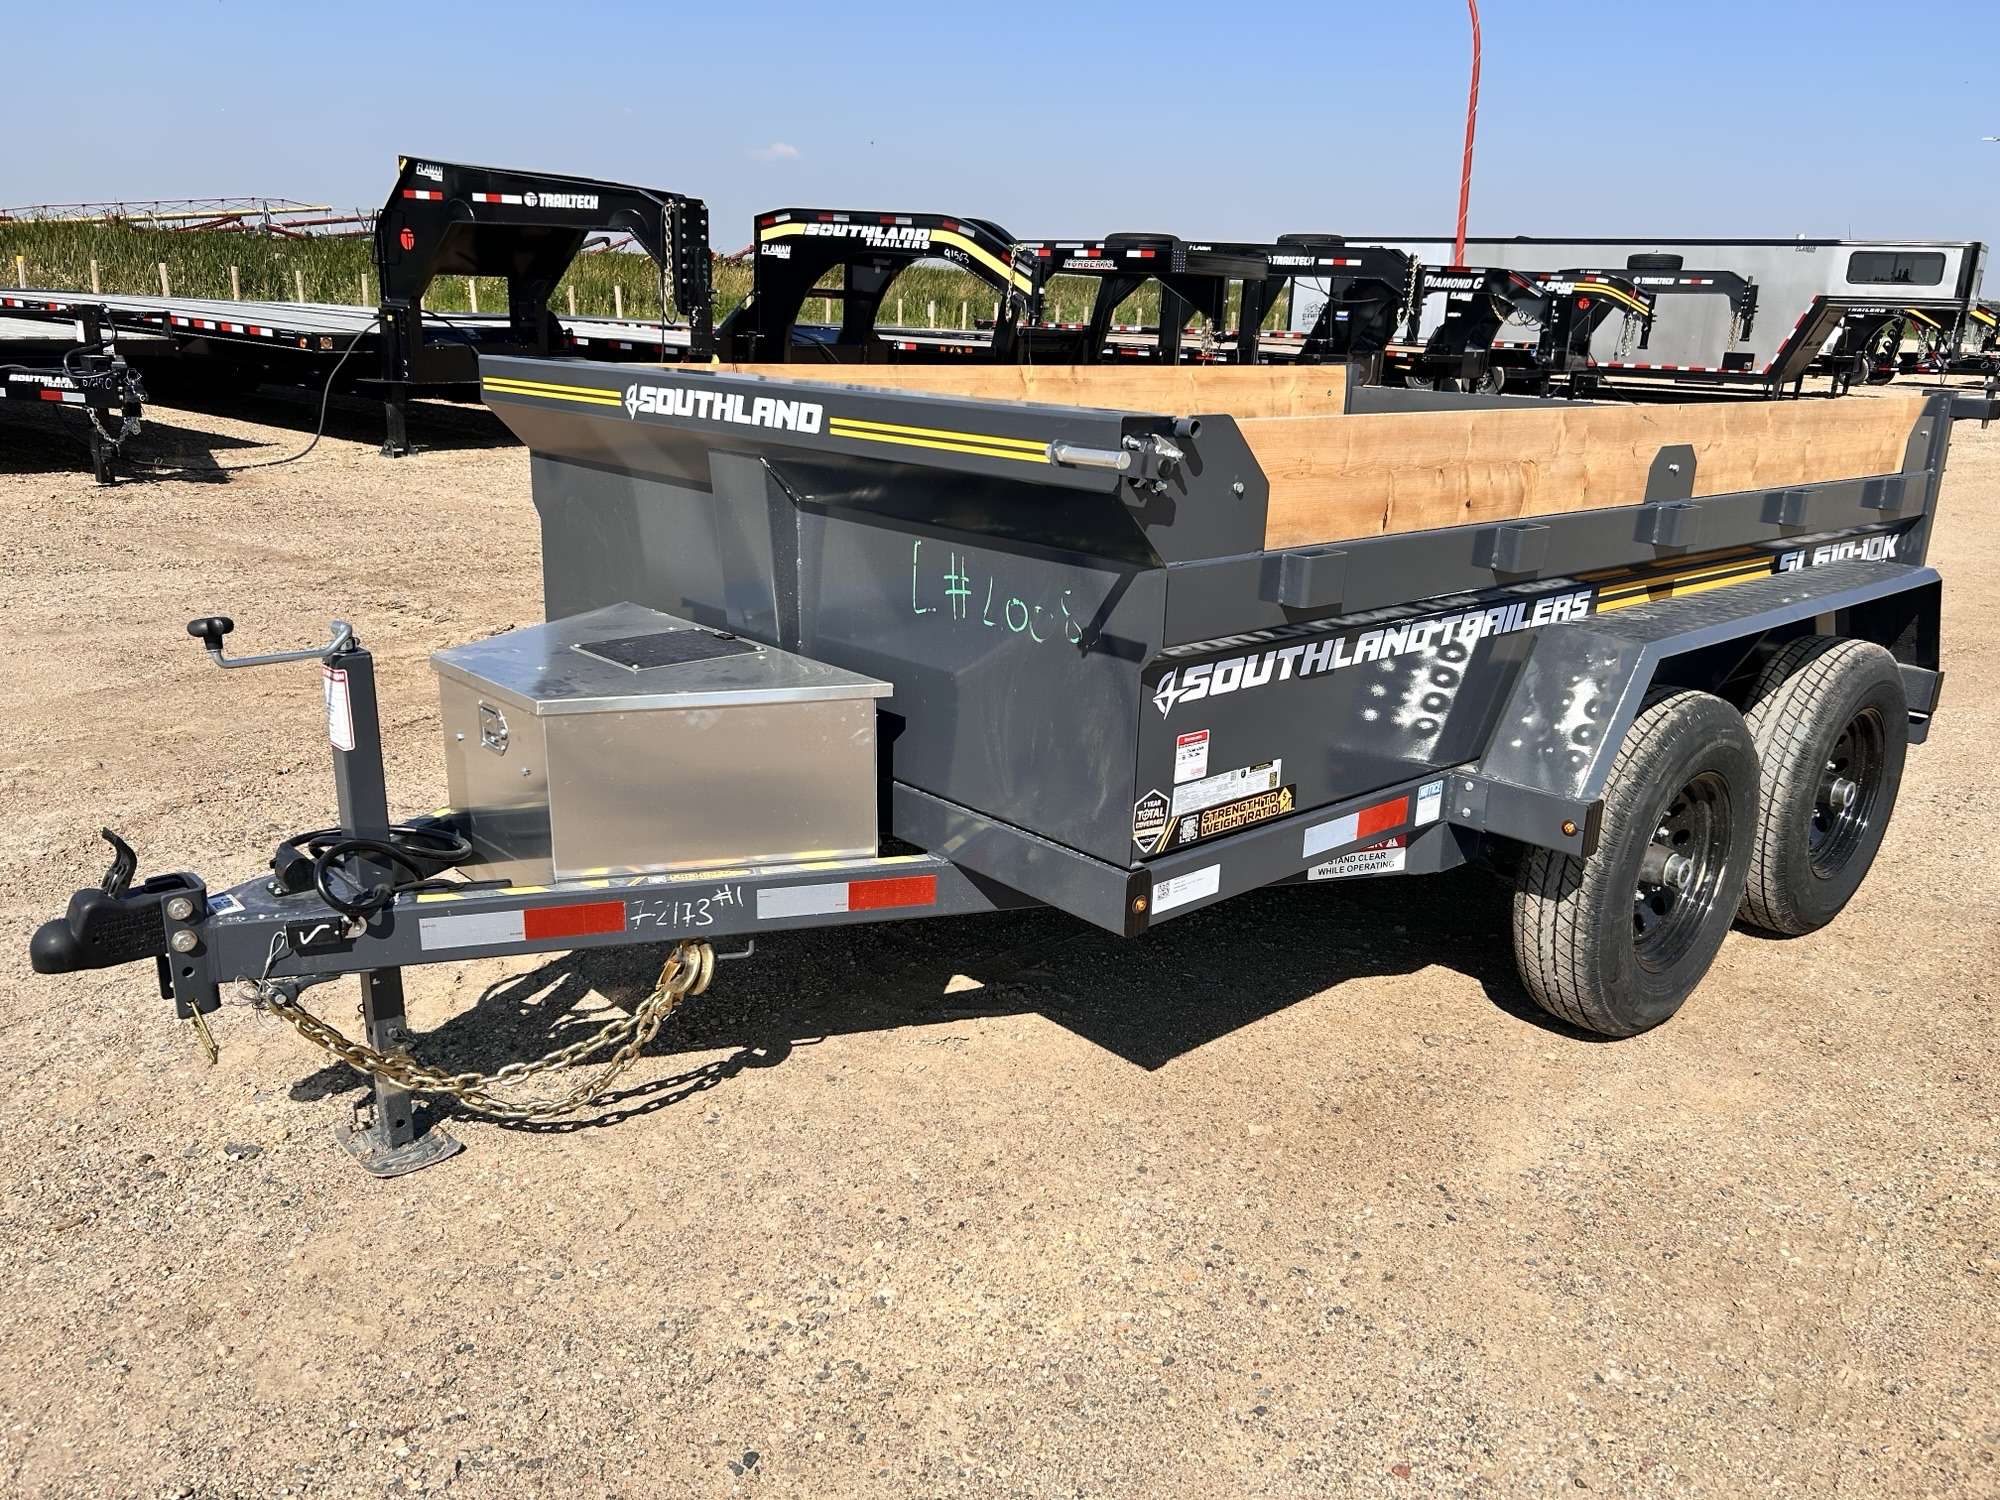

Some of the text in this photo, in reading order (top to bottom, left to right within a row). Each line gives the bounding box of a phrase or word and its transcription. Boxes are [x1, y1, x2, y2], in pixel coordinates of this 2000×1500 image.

[538, 193, 599, 210] TRAILTECH
[804, 223, 931, 241] SOUTHLAND
[865, 237, 931, 250] TRAILERS
[1424, 275, 1485, 289] DIAMOND C
[639, 386, 823, 434] SOUTHLAND
[1178, 590, 1593, 703] SOUTHLAND TRAILERS
[1137, 807, 1165, 821] TOTAL
[1202, 795, 1261, 824] STRENGTH
[1262, 792, 1278, 808] TO
[1136, 818, 1164, 829] COVERAGE
[1202, 803, 1280, 836] WEIGHT RATIO
[1328, 852, 1386, 865] STAND CLEAR
[1318, 860, 1395, 876] WHILE OPERATING
